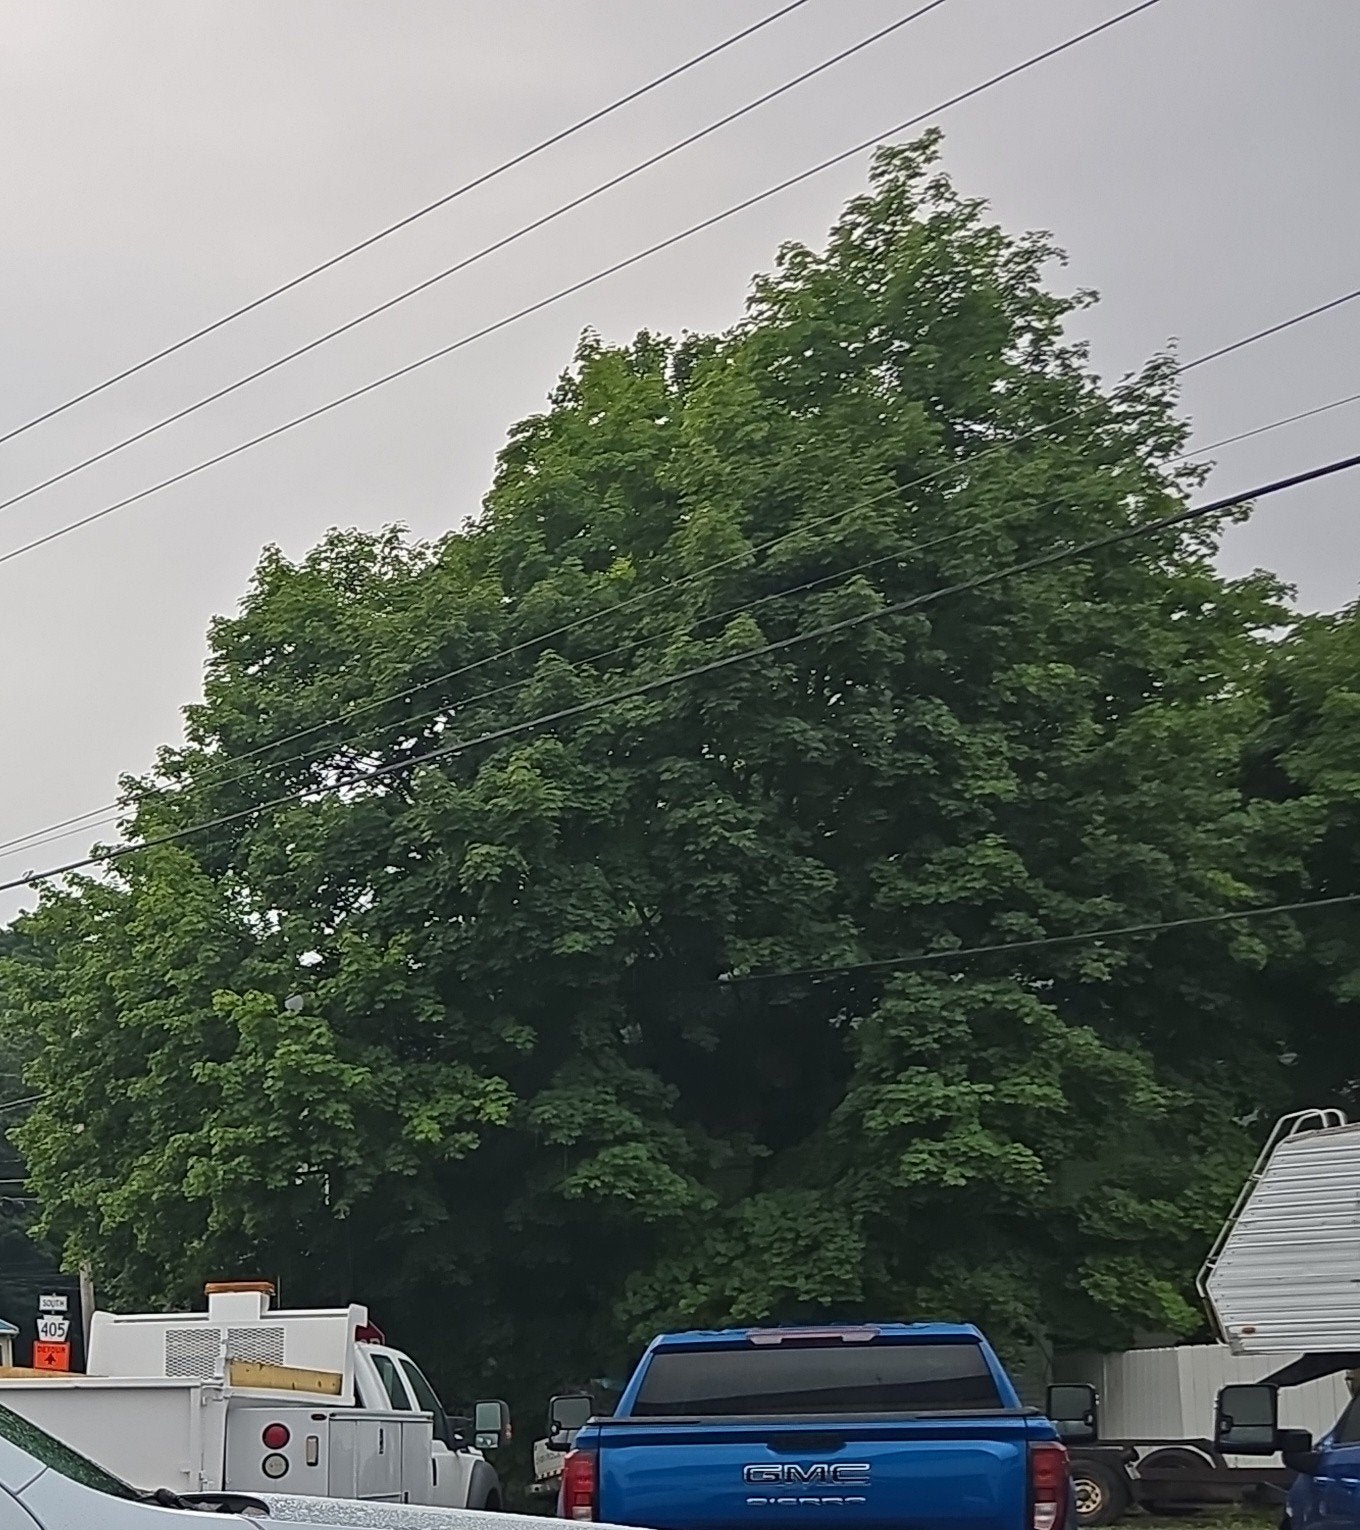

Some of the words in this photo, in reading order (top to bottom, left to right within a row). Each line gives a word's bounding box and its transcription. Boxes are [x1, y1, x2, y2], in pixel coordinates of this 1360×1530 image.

[42, 1299, 65, 1307] SOUTH
[41, 1322, 65, 1338] 405
[743, 1463, 871, 1486] GMC
